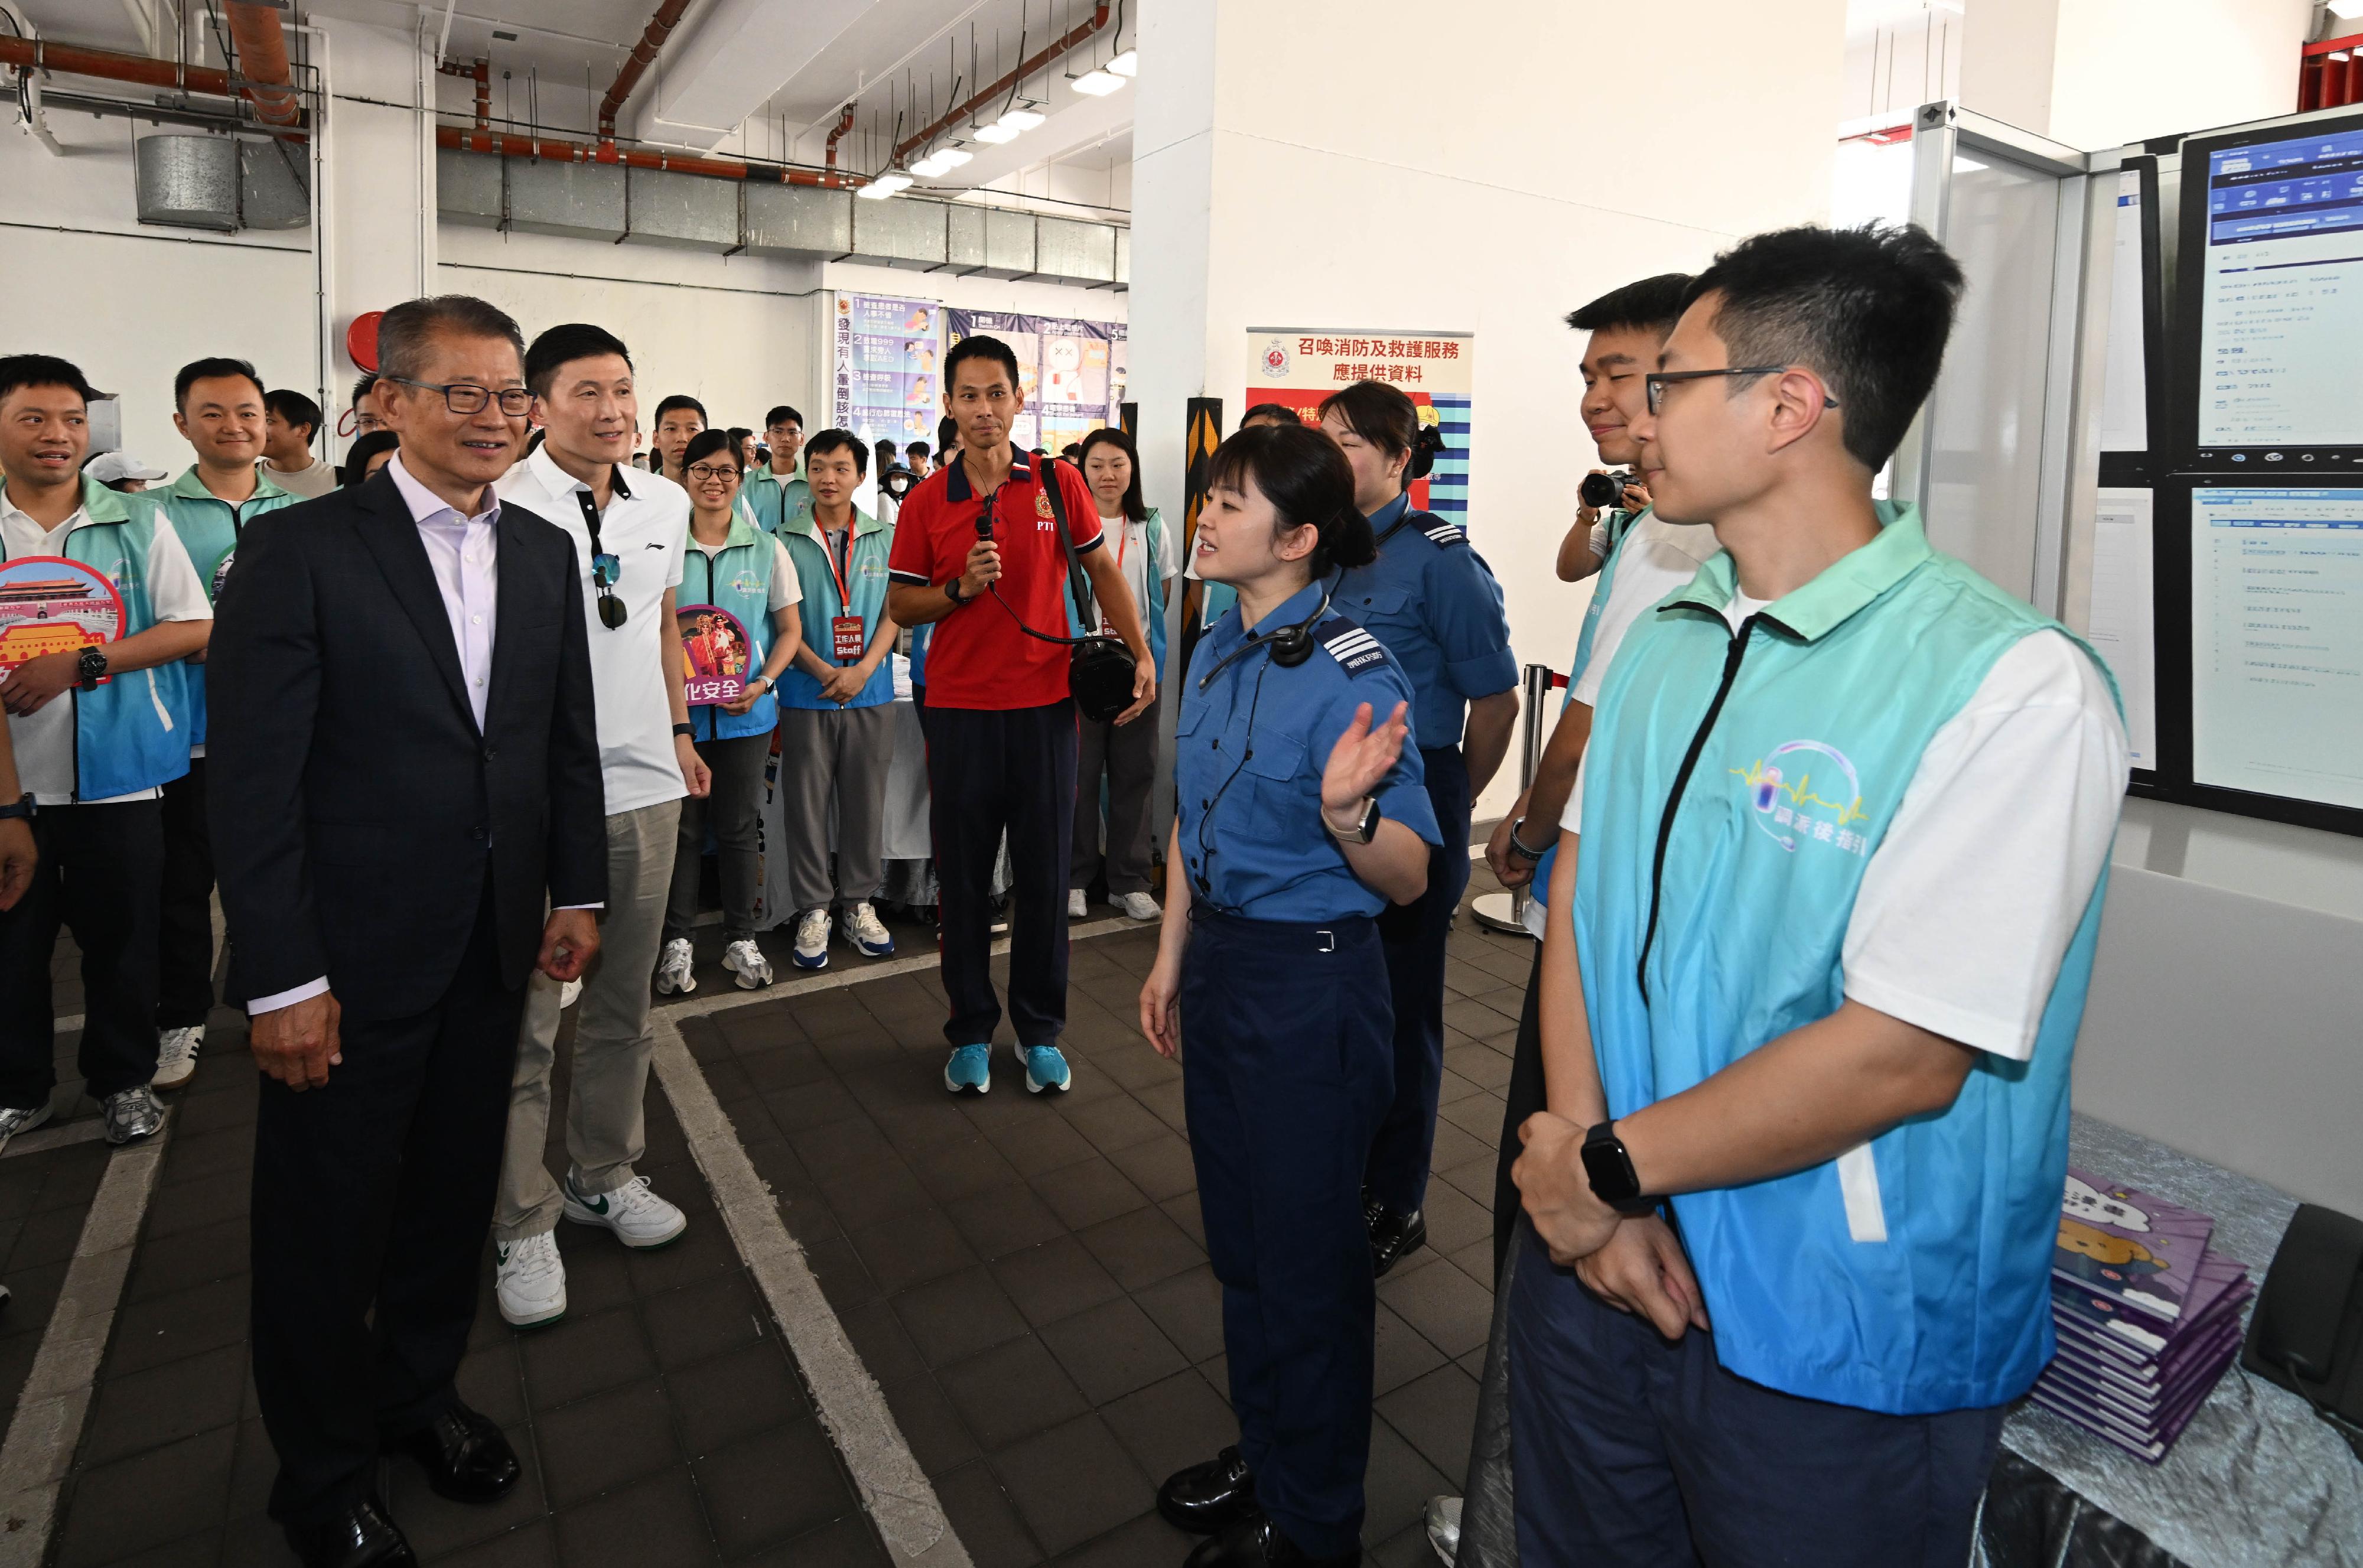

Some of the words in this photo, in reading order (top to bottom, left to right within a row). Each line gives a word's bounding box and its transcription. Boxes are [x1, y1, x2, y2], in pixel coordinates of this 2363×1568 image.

[855, 298, 860, 308] 1
[971, 315, 977, 327] 1
[1043, 322, 1051, 334] 2
[854, 334, 862, 344] 2
[1111, 329, 1118, 340] 5
[1298, 338, 1460, 359] 召喚消防及救護服務
[853, 371, 861, 381] 3
[1333, 363, 1423, 383] 應提供資料
[852, 407, 861, 417] 4
[1041, 404, 1049, 415] 4
[1037, 521, 1054, 532] PTI
[835, 635, 862, 644] 工作人員
[837, 645, 861, 655] Staff
